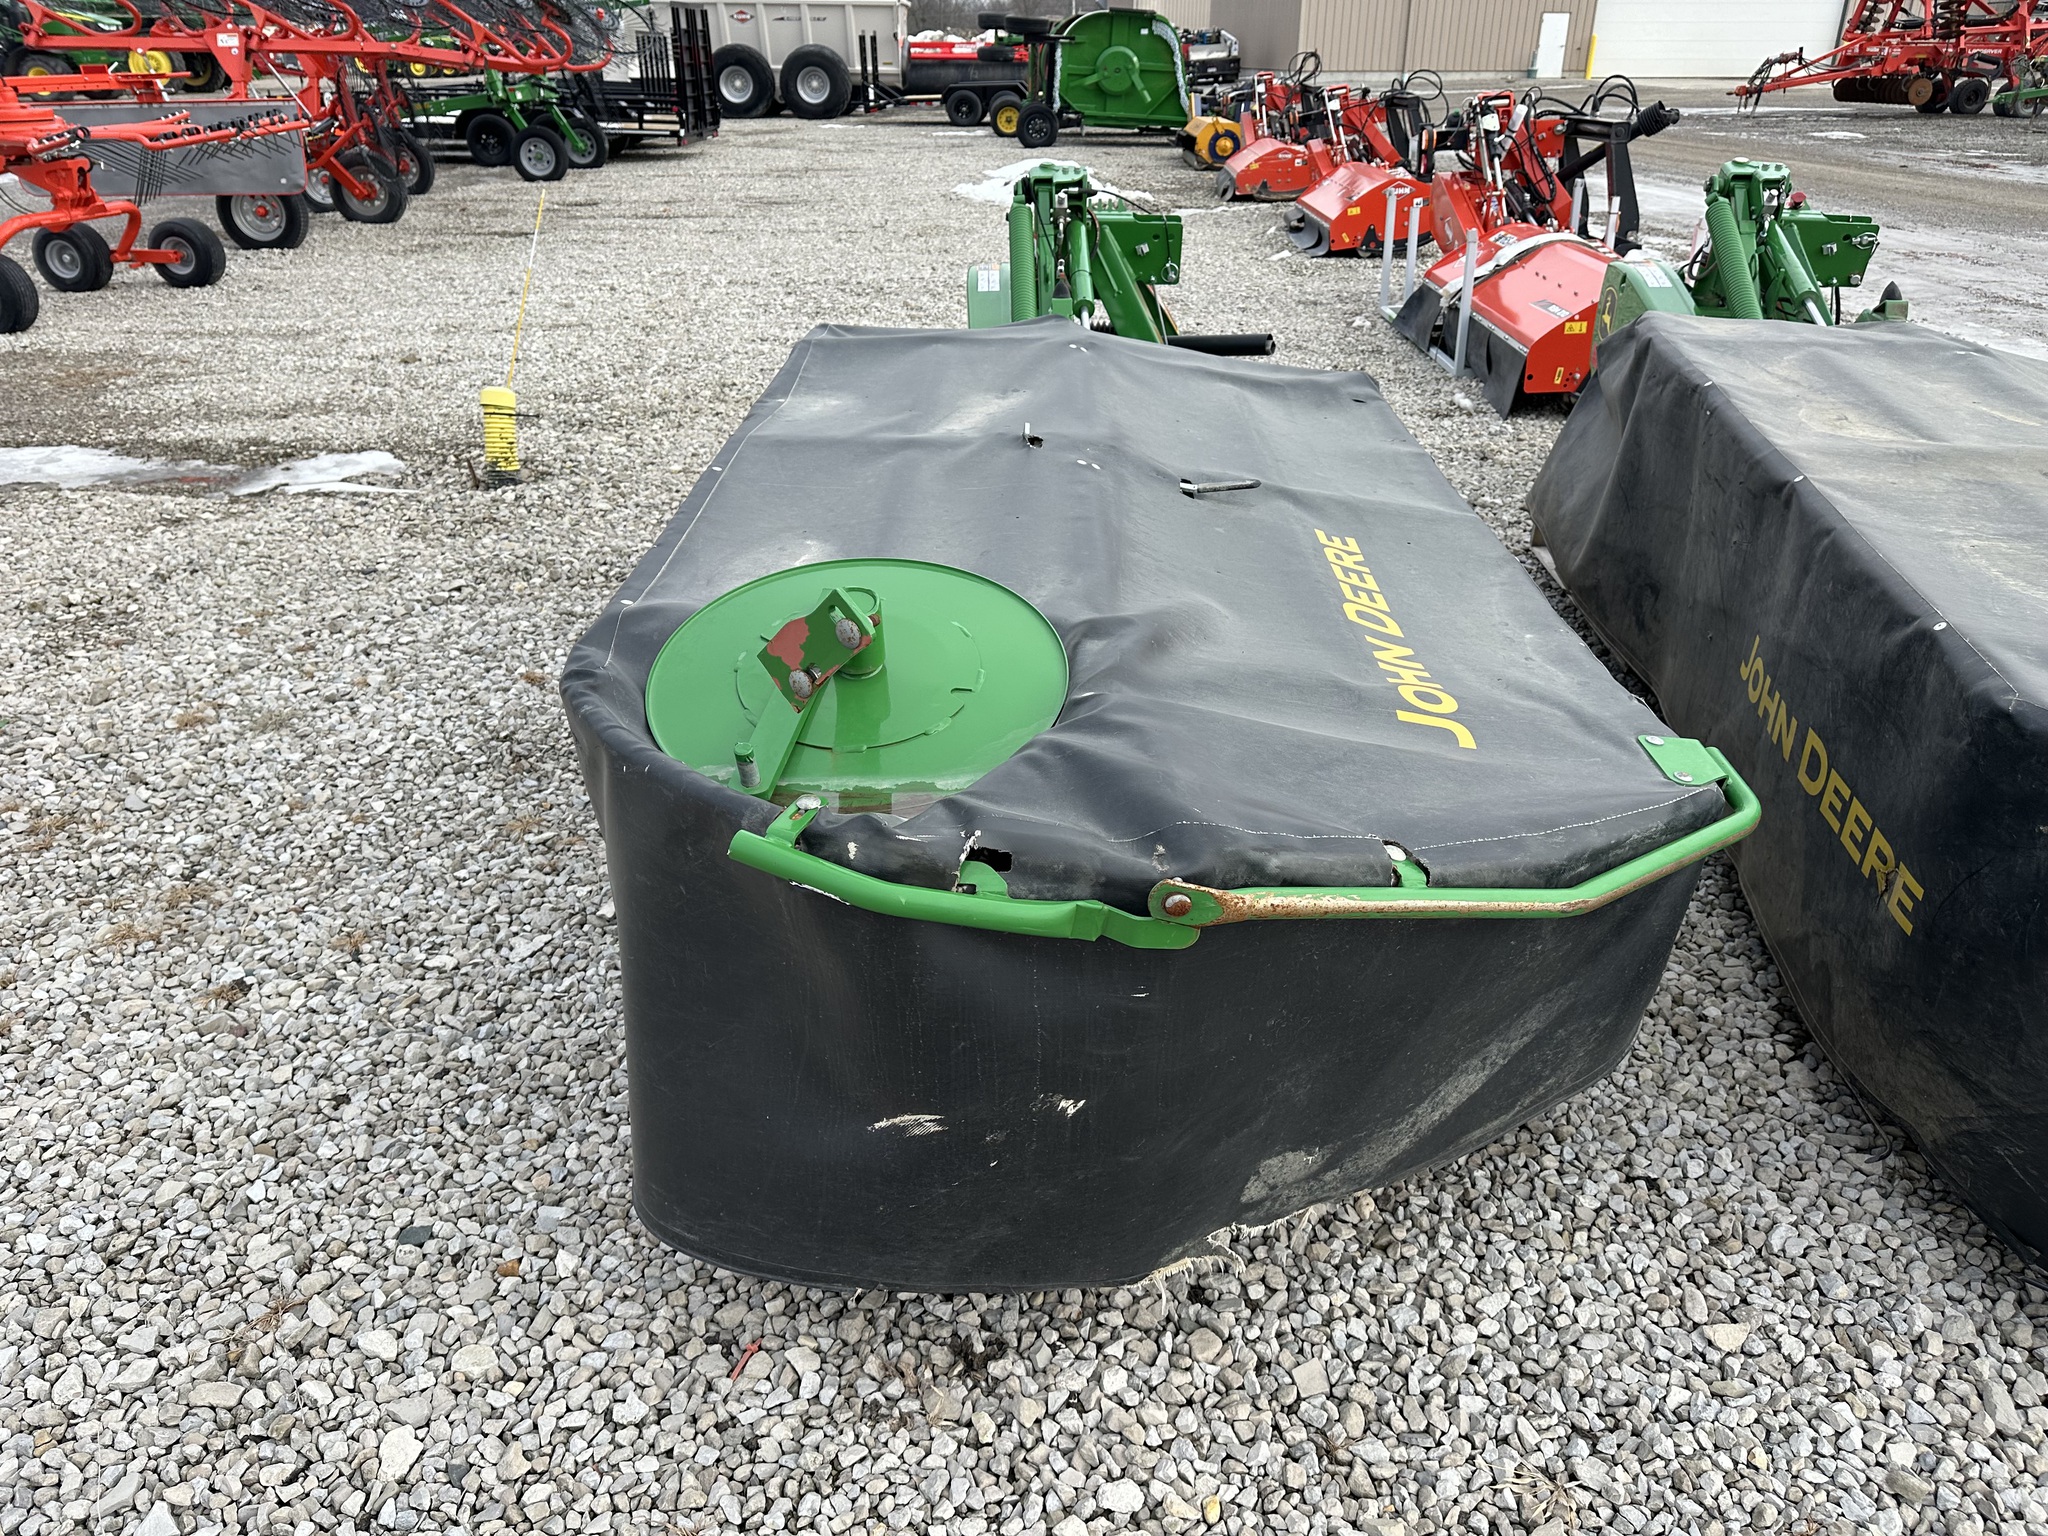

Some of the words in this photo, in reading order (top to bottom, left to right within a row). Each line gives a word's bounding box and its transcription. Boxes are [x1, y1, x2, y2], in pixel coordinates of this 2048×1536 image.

[1314, 528, 1404, 638] DEERE
[1365, 635, 1477, 749] JOHN
[1740, 634, 1798, 762] JOHN
[1797, 727, 1925, 936] DEERE
